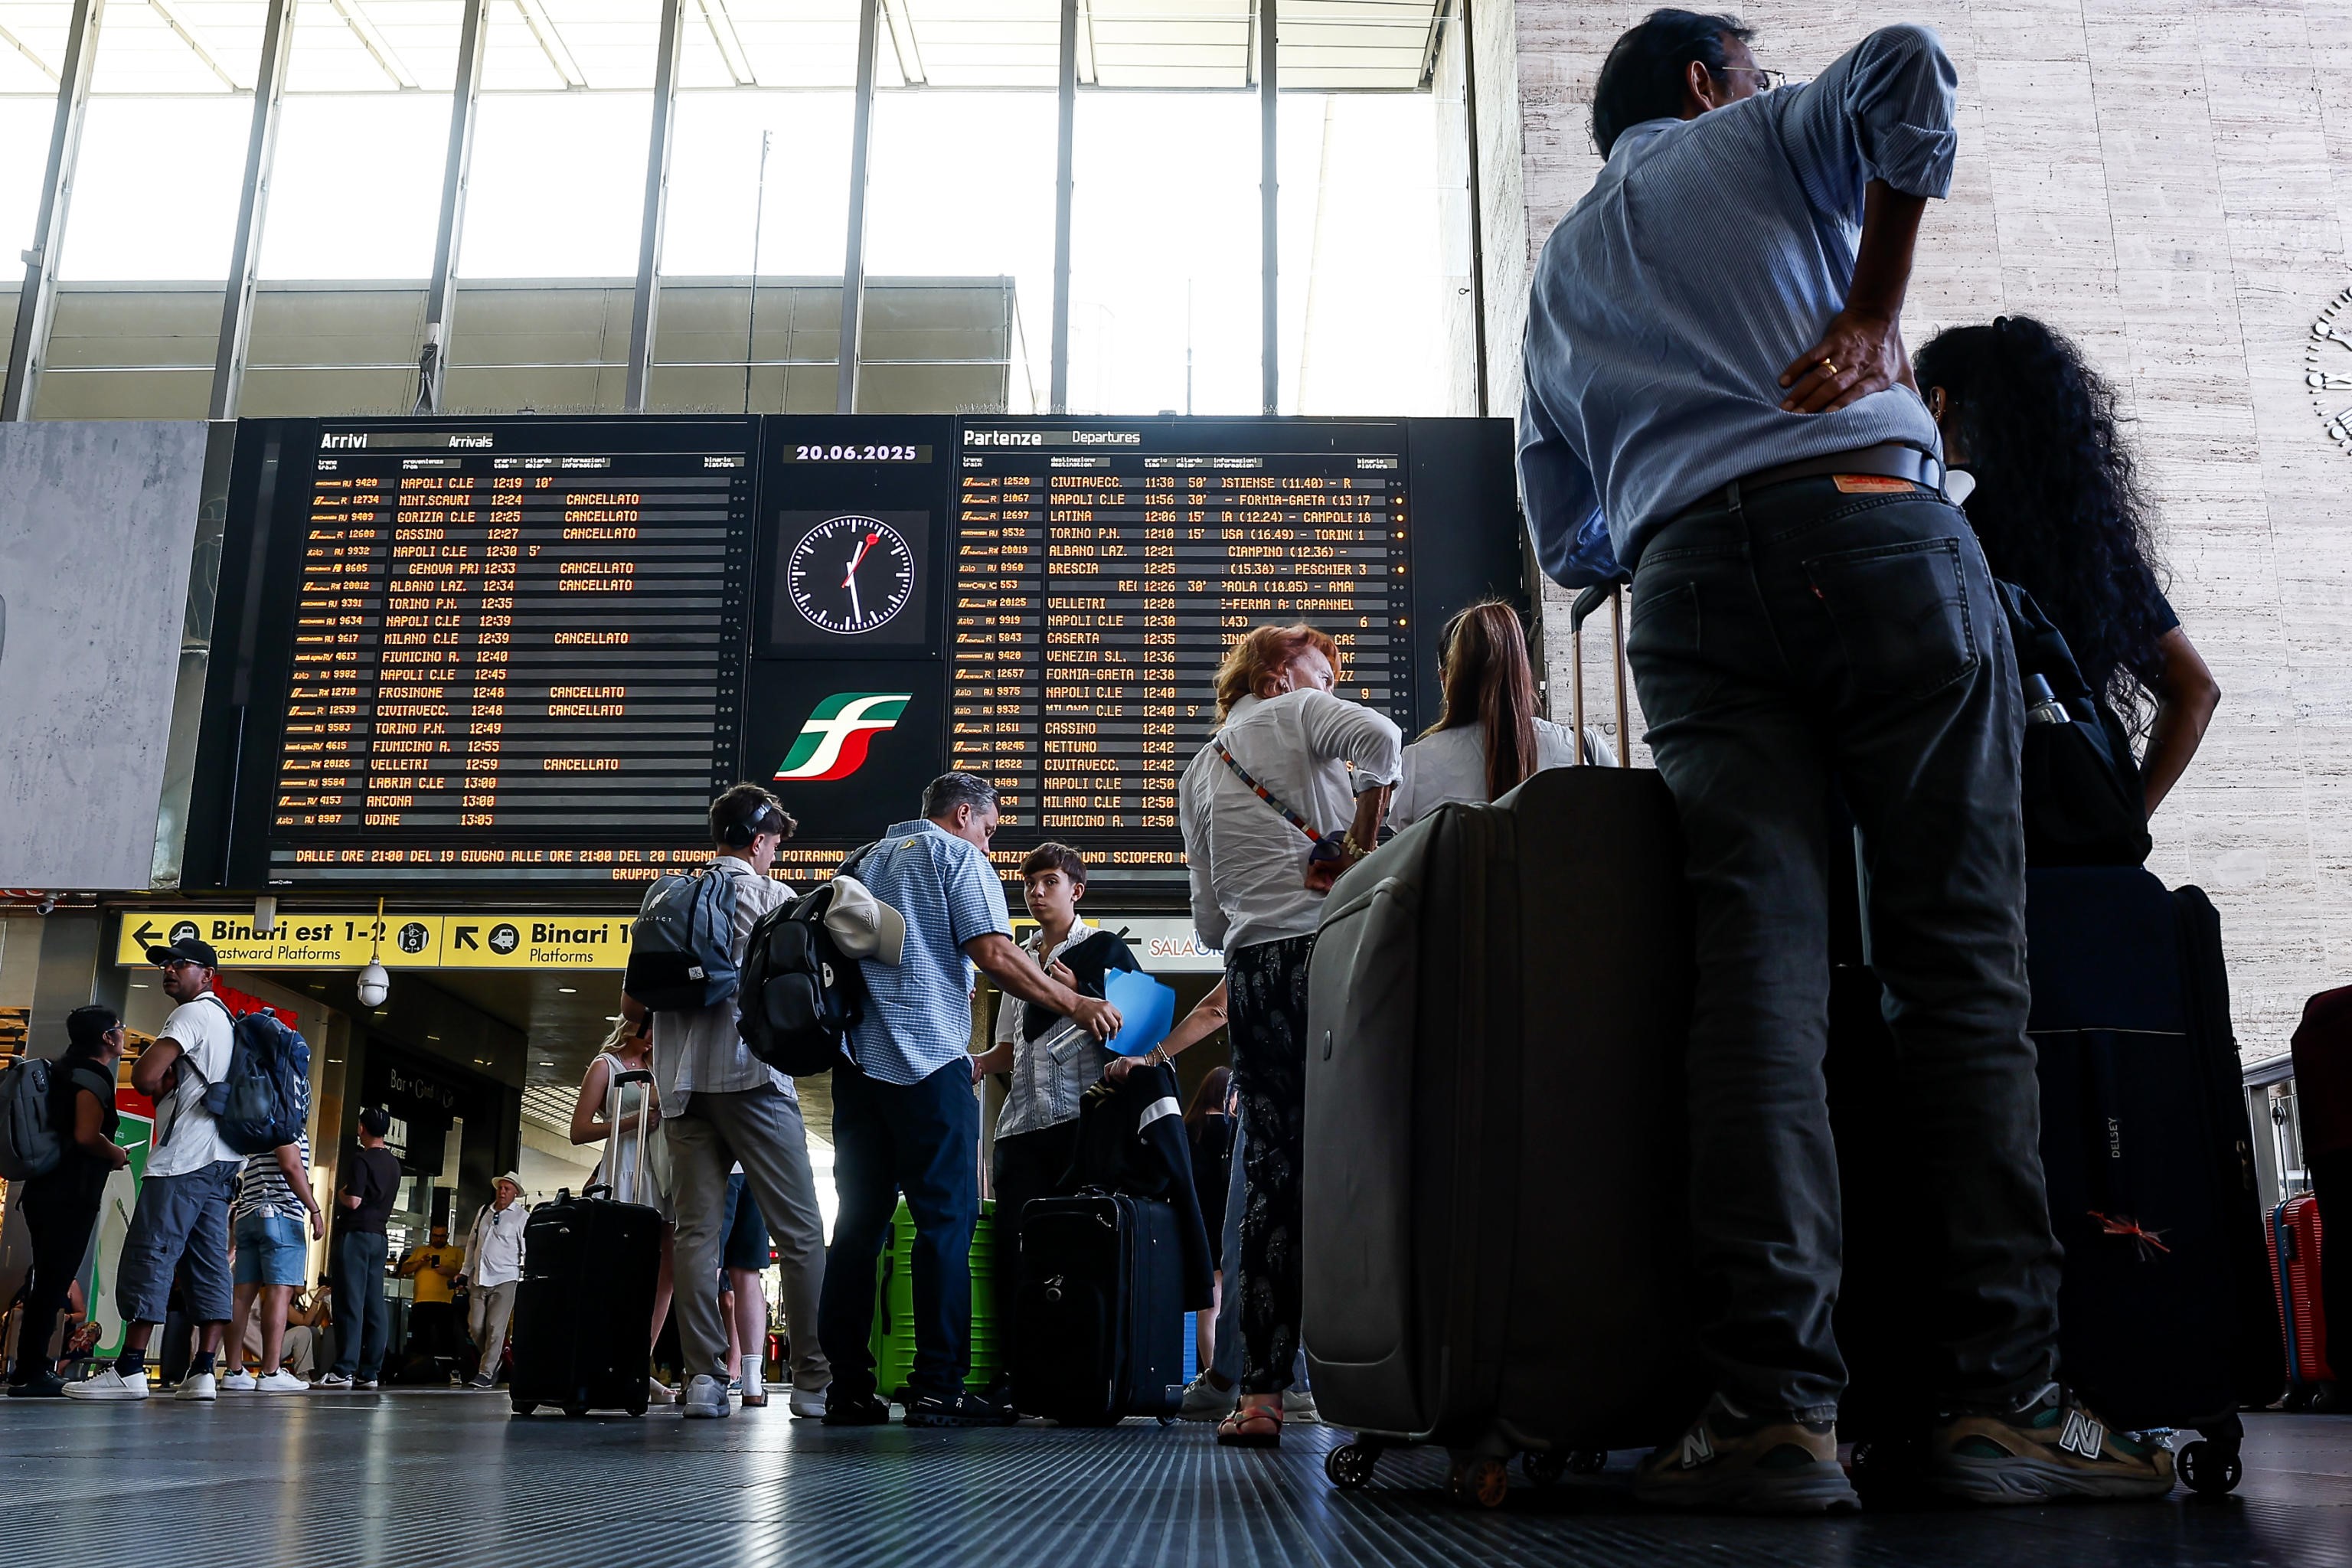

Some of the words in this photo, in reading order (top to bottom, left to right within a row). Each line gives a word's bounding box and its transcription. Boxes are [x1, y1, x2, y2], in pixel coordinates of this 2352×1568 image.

[320, 433, 368, 449] Arrivi
[448, 436, 493, 448] Arrivals
[964, 430, 1042, 446] Partenze
[1072, 430, 1141, 446] Departures
[796, 446, 916, 460] 20.06.2025
[401, 479, 443, 488] NAPOLI
[449, 478, 474, 488] C.LE
[494, 478, 522, 488] 12:19
[1052, 477, 1122, 487] CIVITAVECC.
[1146, 478, 1174, 487] 11:30
[400, 495, 470, 505] MINT.SCAURI
[492, 495, 522, 505] 12:24
[567, 494, 639, 505] CANCELLATO
[1051, 495, 1093, 505] NAPOLI
[1100, 495, 1124, 504] C.LE
[1145, 495, 1174, 505] 11:56
[1357, 495, 1370, 506] 17
[398, 511, 443, 522] GORIZIA
[450, 511, 475, 522] C.LE
[490, 511, 521, 522] 12:25
[565, 511, 637, 521] CANCELLATO
[1051, 511, 1092, 521] LATINA
[1146, 511, 1175, 521] 12:06
[1358, 511, 1371, 523] 18
[396, 529, 443, 539] CASSINO
[488, 528, 519, 539] 12:27
[564, 528, 636, 539] CANCELLATO
[1050, 528, 1091, 538] TORINO
[1099, 528, 1119, 538] P.N.
[1145, 528, 1174, 538] 12:10
[348, 546, 371, 555] 9932
[394, 547, 435, 557] NAPOLI
[442, 546, 467, 557] C.LE
[487, 546, 517, 557] 12:30
[1050, 546, 1093, 556] ALBANO
[1102, 546, 1127, 556] LAZ.
[1145, 546, 1174, 556] 12:21
[409, 564, 453, 574] GENOVA
[485, 564, 515, 573] 12:33
[560, 563, 633, 573] CANCELLATO
[1049, 564, 1098, 573] BRESCIA
[1145, 564, 1175, 573] 12:25
[390, 581, 434, 591] ALBANO
[441, 580, 466, 591] LAZ.
[484, 580, 514, 591] 12:34
[560, 580, 632, 590] CANCELLATO
[389, 599, 430, 609] TORINO
[436, 599, 456, 609] P.N.
[482, 598, 512, 609] 12:35
[1048, 598, 1105, 609] VELLETRI
[339, 616, 364, 625] 9634
[387, 616, 428, 626] NAPOLI
[435, 616, 460, 626] C.LE
[480, 616, 511, 626] 12:39
[1048, 616, 1090, 626] NAPOLI
[1098, 616, 1123, 626] C.LE
[385, 634, 426, 644] MILANO
[433, 633, 458, 644] C.LE
[479, 633, 509, 644] 12:39
[555, 633, 629, 644] CANCELLATO
[1047, 633, 1099, 643] CASERTA
[383, 652, 442, 662] FIUMICINO
[449, 652, 459, 662] A.
[477, 652, 508, 662] 12:40
[1047, 651, 1097, 662] VENEZIA
[1105, 652, 1125, 662] S.L.
[381, 670, 423, 680] NAPOLI
[430, 669, 455, 680] C.LE
[475, 669, 506, 679] 12:45
[1047, 669, 1134, 680] FORMIA-GAETA
[379, 688, 443, 697] FROSINONE
[474, 688, 505, 697] 12:48
[550, 687, 624, 697] CANCELLATO
[1047, 688, 1089, 697] NAPOLI
[1097, 687, 1122, 697] C.LE
[377, 705, 450, 716] CIVITAVECC.
[472, 705, 502, 716] 12:48
[549, 705, 623, 716] CANCELLATO
[376, 724, 416, 734] TORINO
[423, 724, 445, 733] P.N.
[470, 724, 502, 733] 12:49
[1046, 724, 1096, 733] CASSINO
[373, 741, 433, 752] FIUMICINO
[439, 741, 450, 752] A.
[469, 741, 500, 752] 12:55
[1045, 741, 1096, 753] NETTUNO
[371, 760, 429, 770] VELLETRI
[466, 760, 499, 769] 12:59
[544, 760, 619, 770] CANCELLATO
[1045, 760, 1119, 770] CIVITAVECC.
[419, 778, 444, 789] C.LE
[465, 778, 498, 789] 13:00
[1045, 778, 1089, 789] NAPOLI
[1096, 778, 1121, 789] C.LE
[1143, 779, 1174, 789] 12:50
[367, 796, 413, 806] ANCONA
[463, 795, 495, 806] 13:00
[1044, 796, 1086, 808] MILANO
[1095, 797, 1120, 808] C.LE
[365, 815, 400, 825] UDINE
[462, 815, 493, 825] 13:05
[1044, 815, 1104, 826] FIUMICINO
[1112, 815, 1123, 826] A.
[296, 851, 335, 861] DALLE
[341, 851, 364, 861] ORE
[371, 851, 403, 861] 21:00
[410, 851, 433, 861] DEL
[440, 851, 454, 861] 19
[462, 851, 505, 861] GIUGNO
[511, 851, 542, 861] ALLE
[550, 851, 572, 861] ORE
[580, 851, 612, 861] 21:00
[619, 851, 641, 861] DEL
[650, 851, 666, 861] 20
[782, 851, 844, 862] POTRANNO
[987, 851, 1031, 863] RIAZI
[1114, 852, 1174, 863] SCIOPERO
[612, 869, 659, 880] GRUPPO
[296, 923, 333, 941] est
[531, 923, 609, 944] Binari
[278, 946, 341, 960] Platforms
[529, 947, 593, 962] Platforms
[2108, 1117, 2120, 1158] DELSEY
